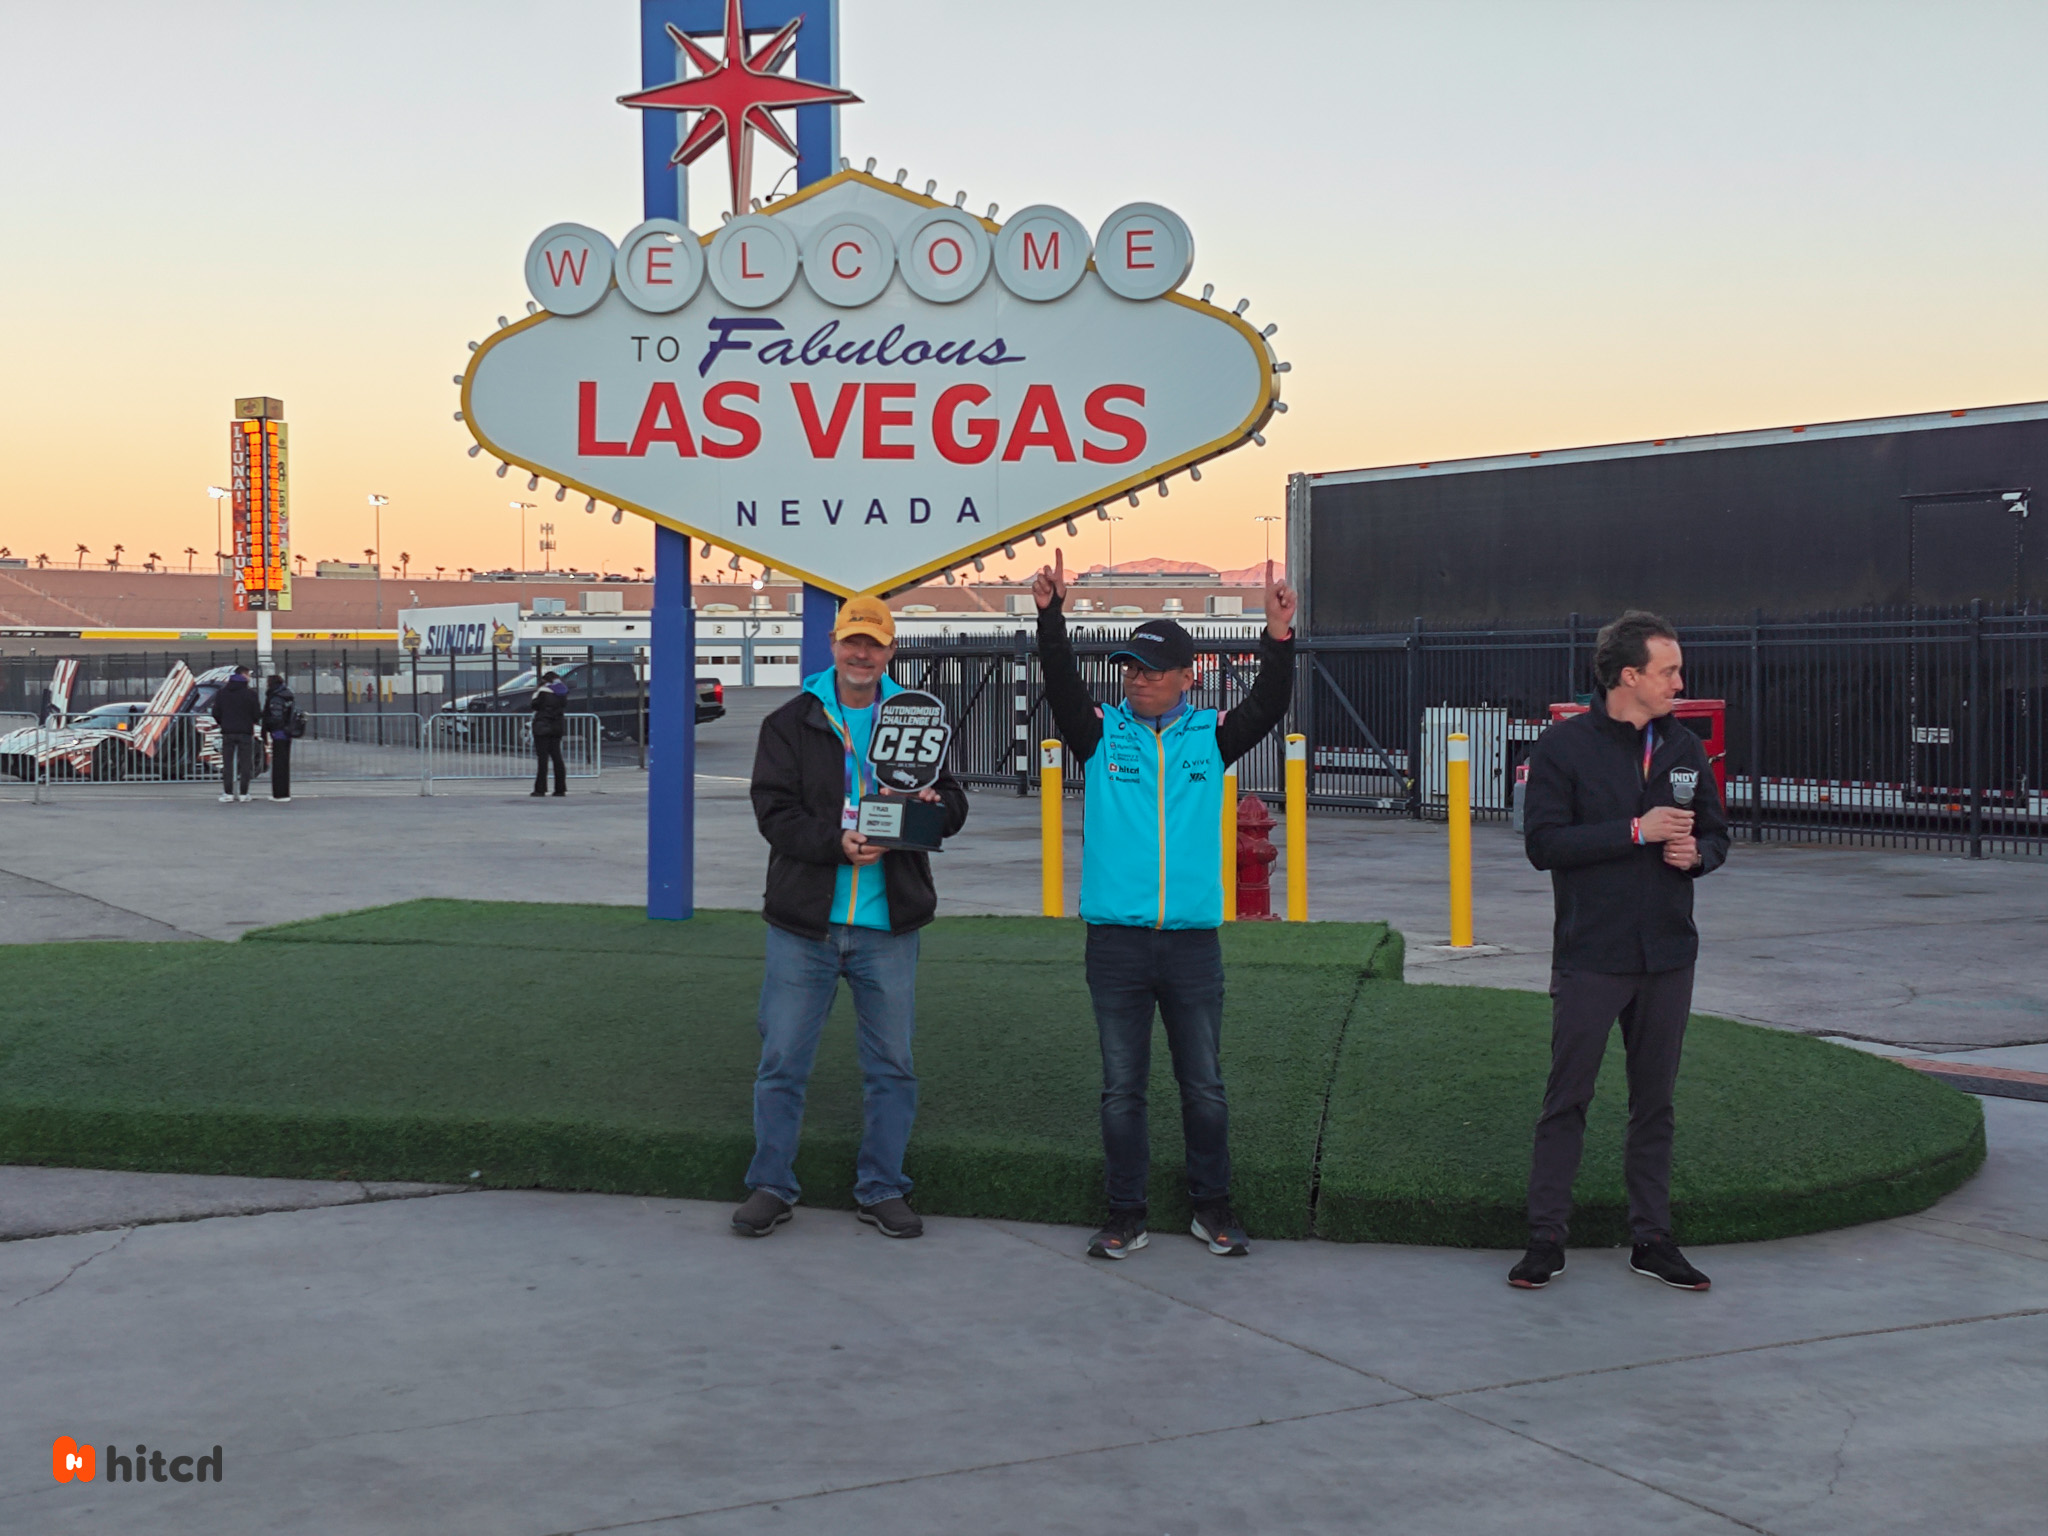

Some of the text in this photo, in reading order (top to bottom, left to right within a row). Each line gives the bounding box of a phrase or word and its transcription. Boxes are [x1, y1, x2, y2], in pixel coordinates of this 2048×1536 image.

[545, 230, 1155, 288] WELCOME
[631, 316, 1027, 379] TO Fabulous
[577, 380, 1148, 466] LAS VEGAS
[737, 497, 981, 528] NEVADA
[426, 623, 486, 656] SUNOCO
[716, 625, 723, 634] 2
[774, 625, 781, 634] 3
[881, 715, 930, 726] CHALLENGE
[882, 705, 941, 716] AUTONOMOUS
[872, 726, 945, 763] CES
[1669, 771, 1699, 784] INDY
